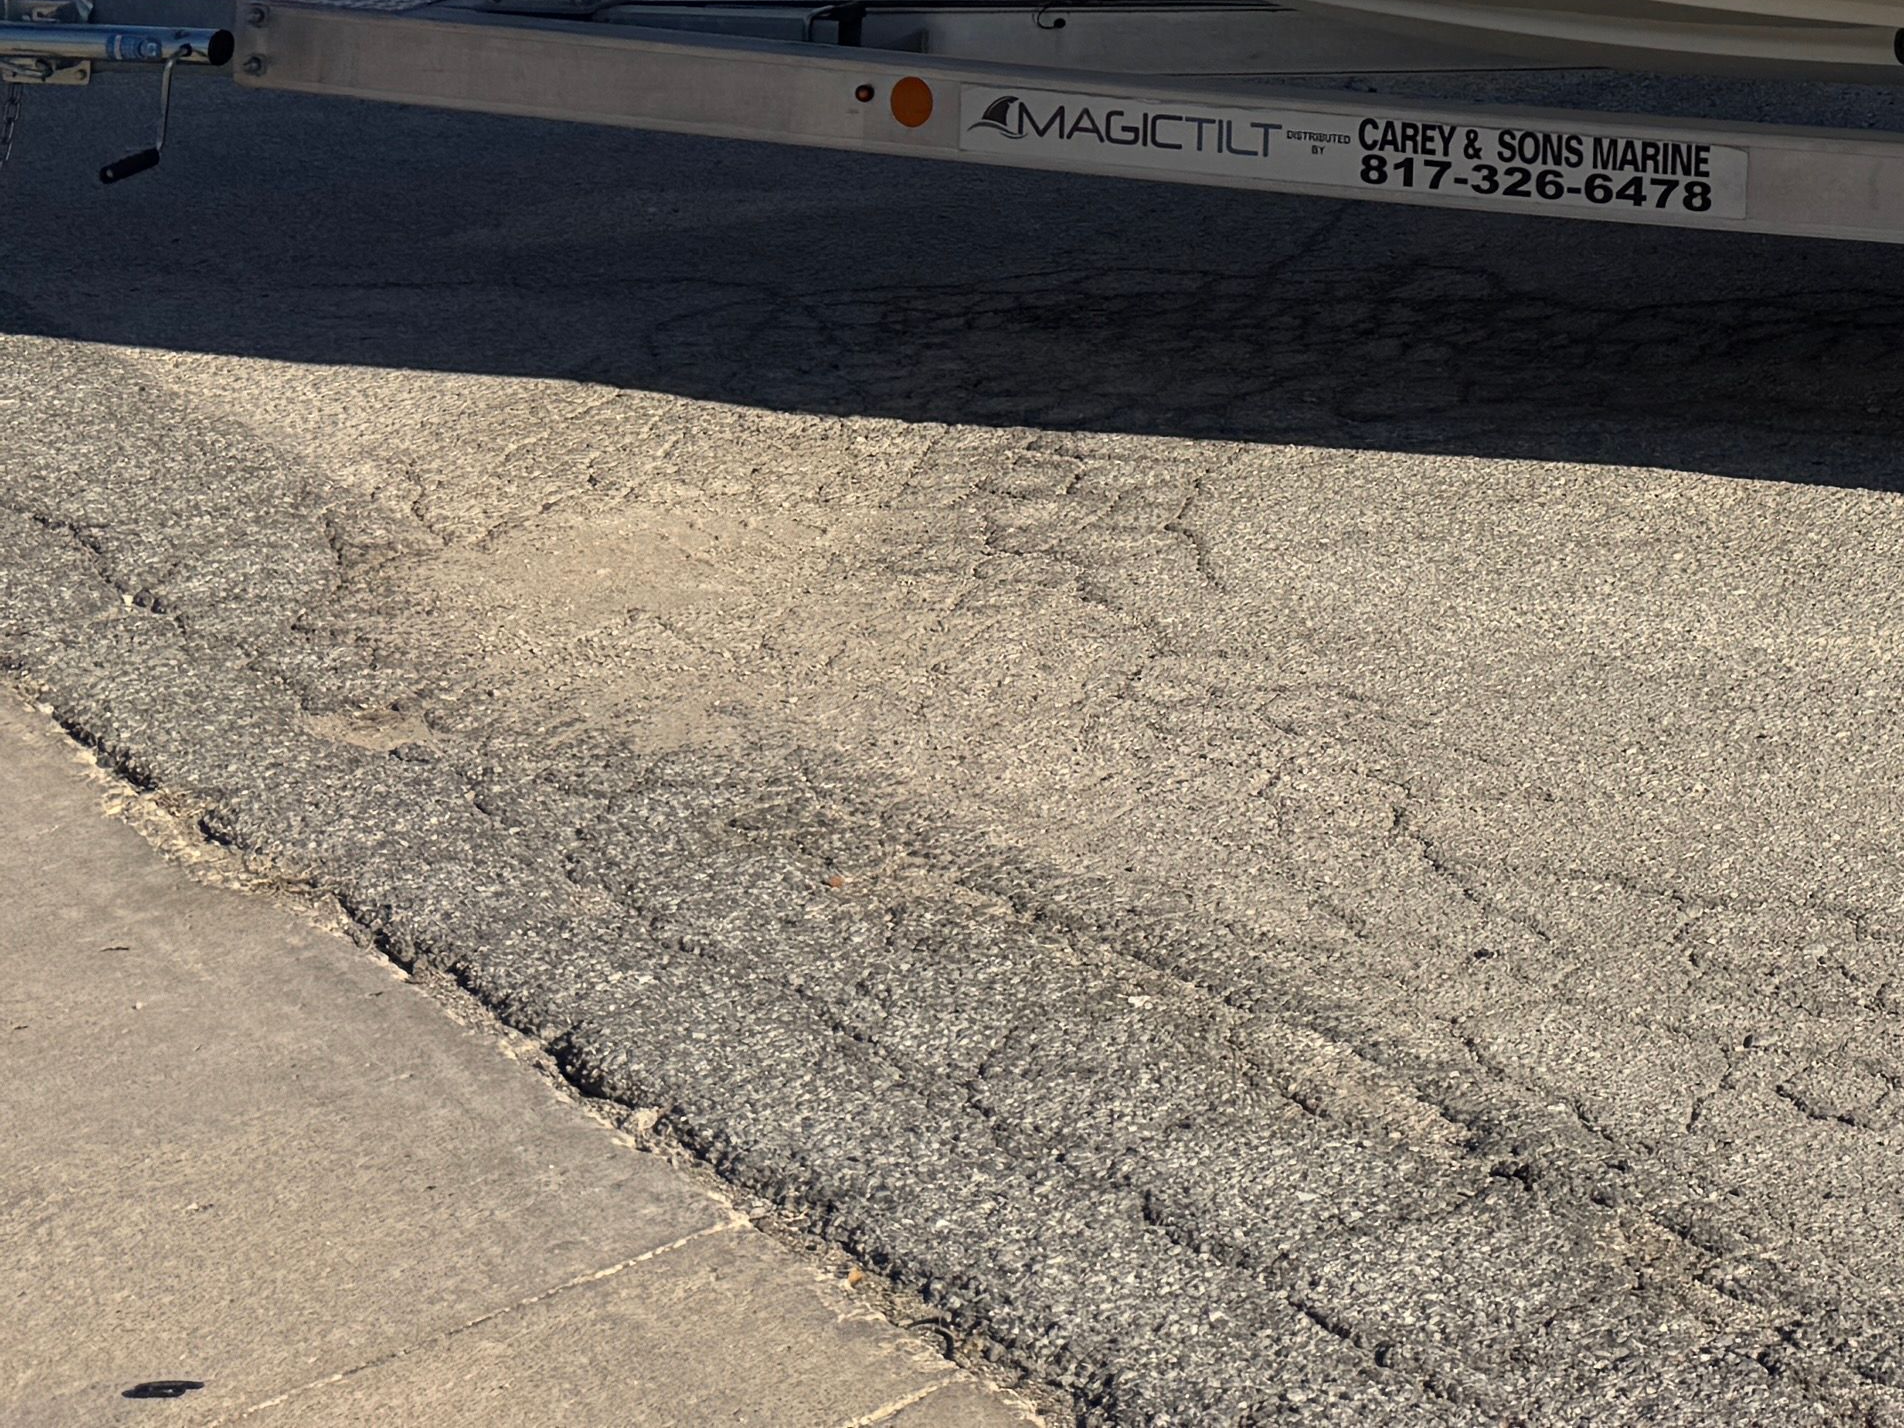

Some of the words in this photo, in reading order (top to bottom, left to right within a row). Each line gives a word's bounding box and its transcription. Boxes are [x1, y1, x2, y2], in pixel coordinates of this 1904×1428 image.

[1017, 101, 1283, 158] MAGICTILT
[1286, 130, 1352, 145] DISTRIBUTED
[1311, 145, 1326, 155] BY
[1358, 117, 1457, 157] CAREY
[1463, 129, 1483, 161] &
[1497, 128, 1584, 169] SONS
[1592, 137, 1711, 178] MARINE
[1359, 154, 1713, 213] 817-326-6478
